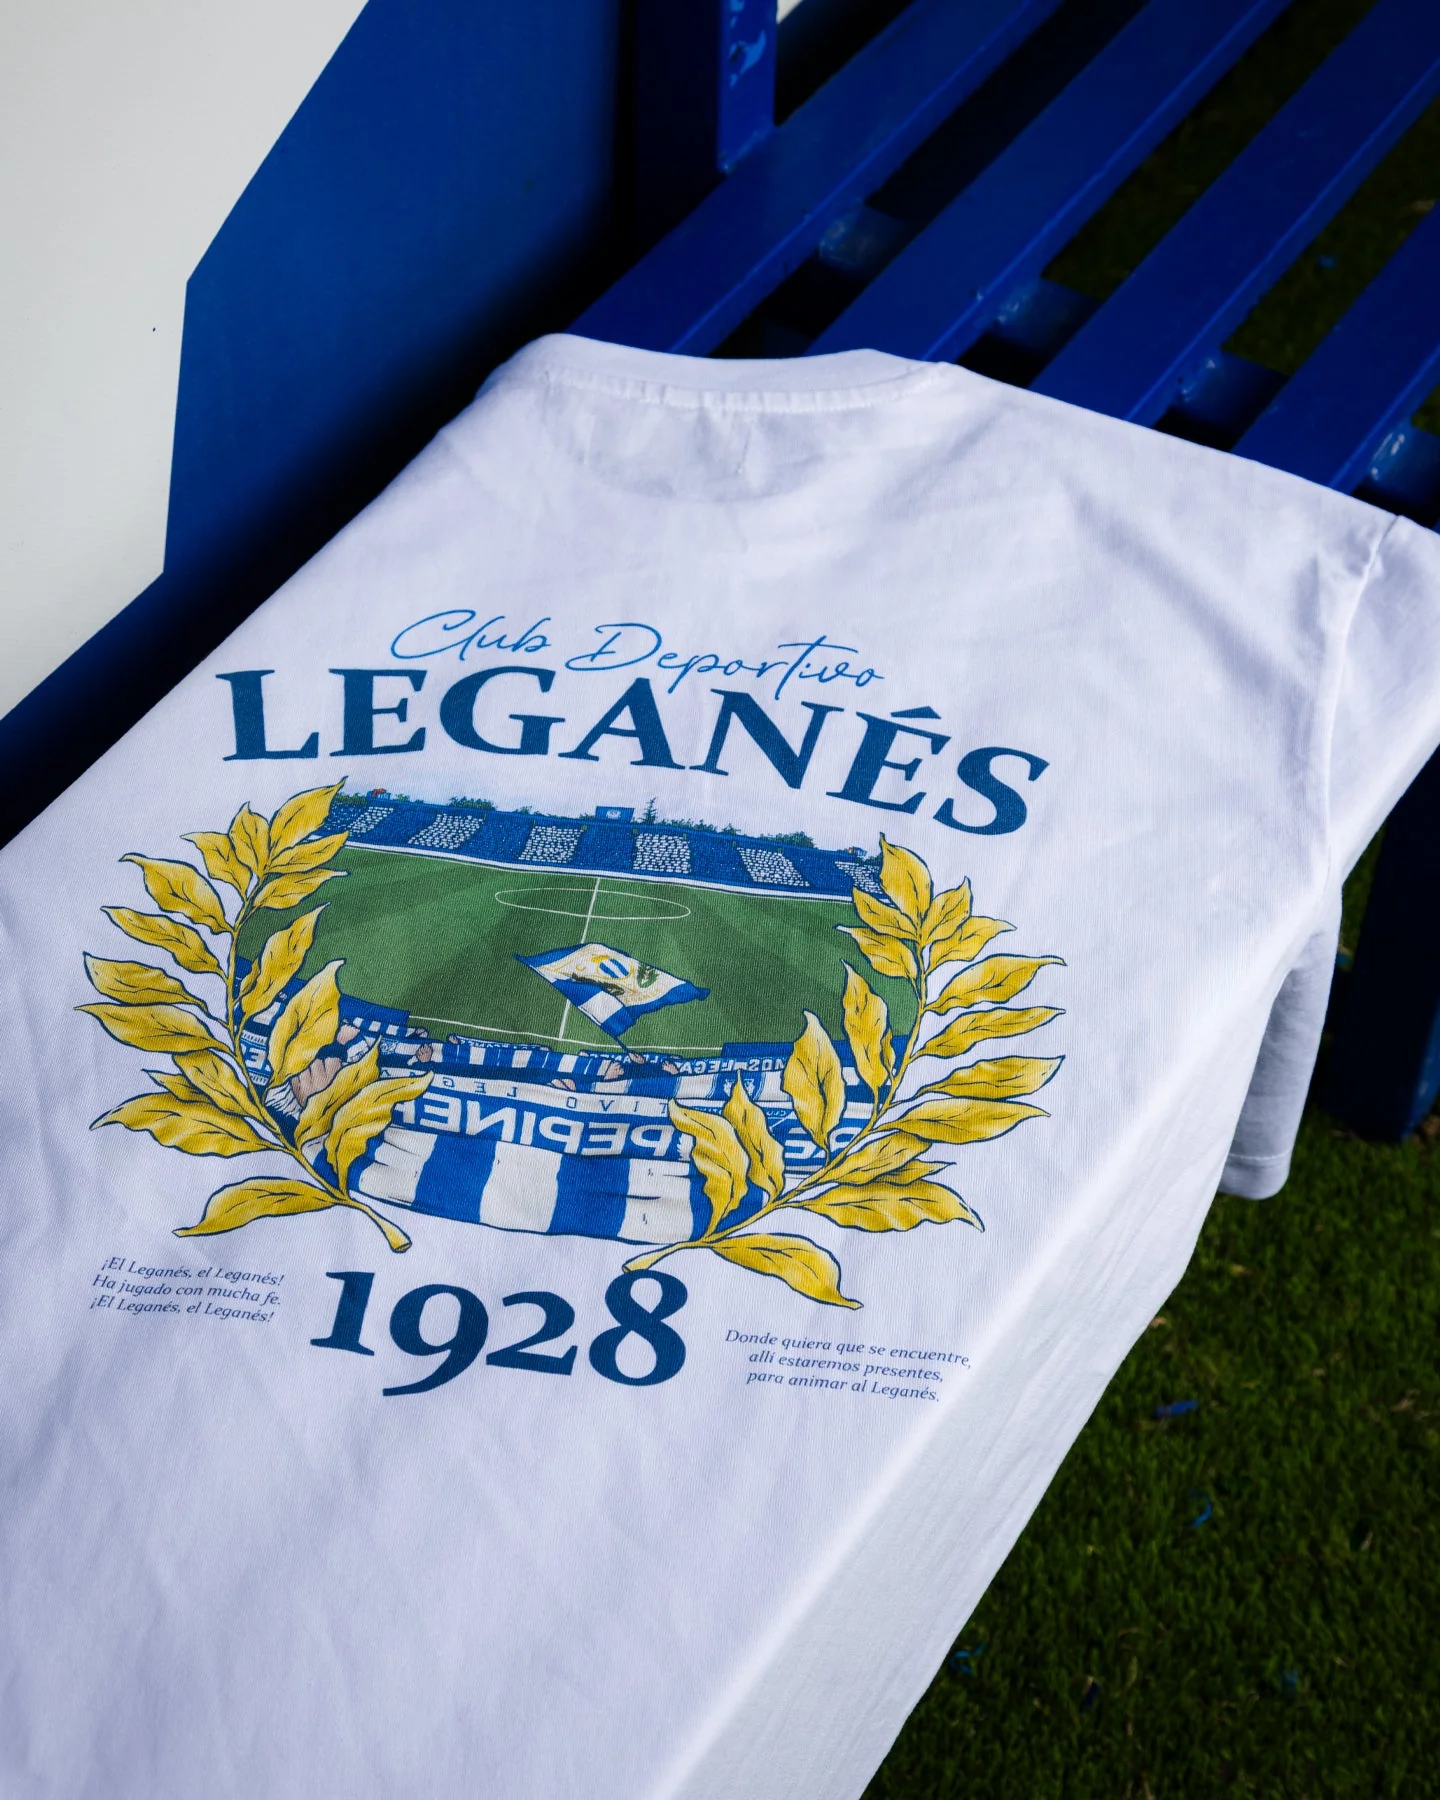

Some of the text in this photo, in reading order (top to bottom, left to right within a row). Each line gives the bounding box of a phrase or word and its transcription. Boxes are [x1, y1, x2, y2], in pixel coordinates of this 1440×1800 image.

[391, 609, 886, 700] Club Deportivo
[215, 666, 1051, 836] LEGANÉS
[101, 1256, 285, 1286] ¡El Leganés, el Leganés!
[92, 1274, 282, 1306] Ha jugado con mucha fe.
[90, 1293, 275, 1322] ¡El Leganés, el Leganés!
[310, 1269, 688, 1397] 1928
[725, 1329, 972, 1369] Donde quiera que se encuentre,
[778, 1354, 860, 1372] estaremos
[863, 1363, 944, 1383] presentes,
[746, 1370, 940, 1402] para animar al Leganés.
